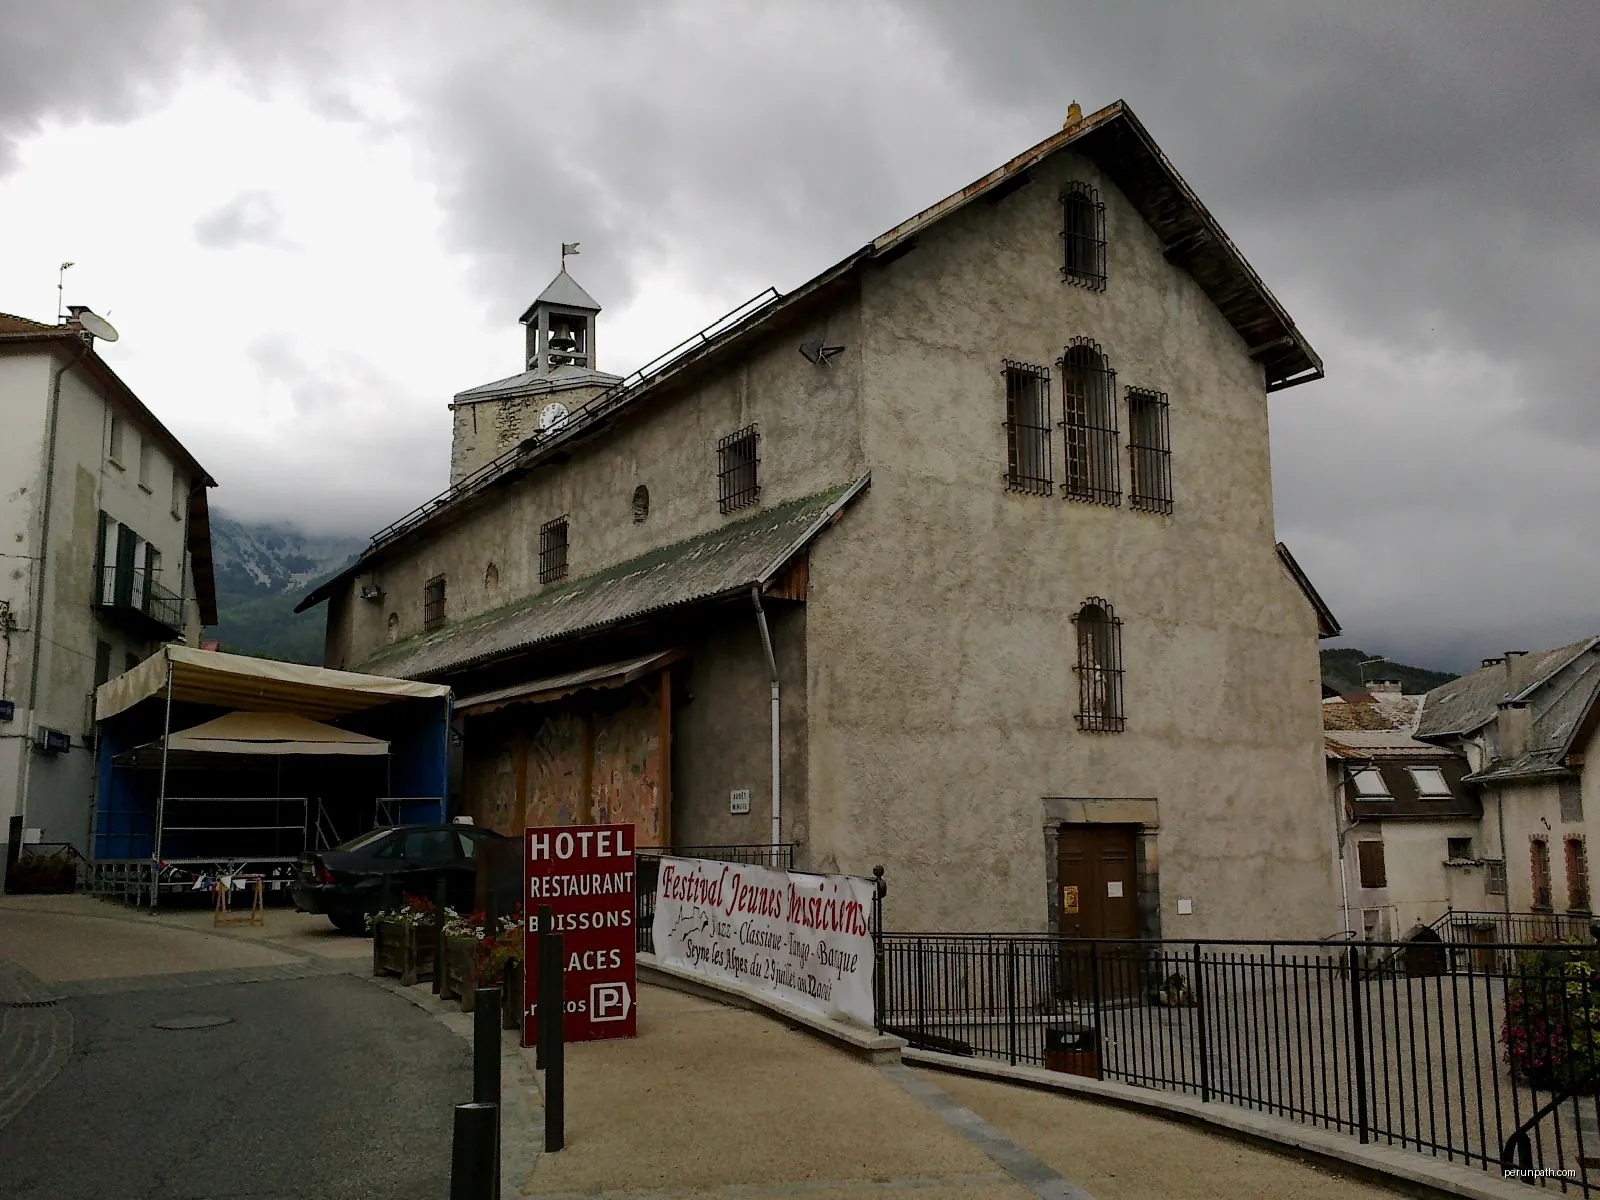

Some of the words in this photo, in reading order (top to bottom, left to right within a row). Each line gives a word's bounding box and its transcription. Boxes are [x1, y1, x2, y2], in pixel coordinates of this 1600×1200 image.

[531, 830, 632, 860] HOTEL
[531, 872, 633, 898] RESTAURANT
[663, 866, 729, 907] Festival
[726, 873, 782, 919] Jeunes
[740, 919, 782, 955] Classique
[563, 949, 621, 971] ACES
[686, 939, 709, 966] Seyne
[712, 941, 724, 966] les
[724, 947, 748, 978] Alpes
[750, 953, 762, 977] du
[764, 959, 775, 981] 29
[600, 988, 619, 1016] P
